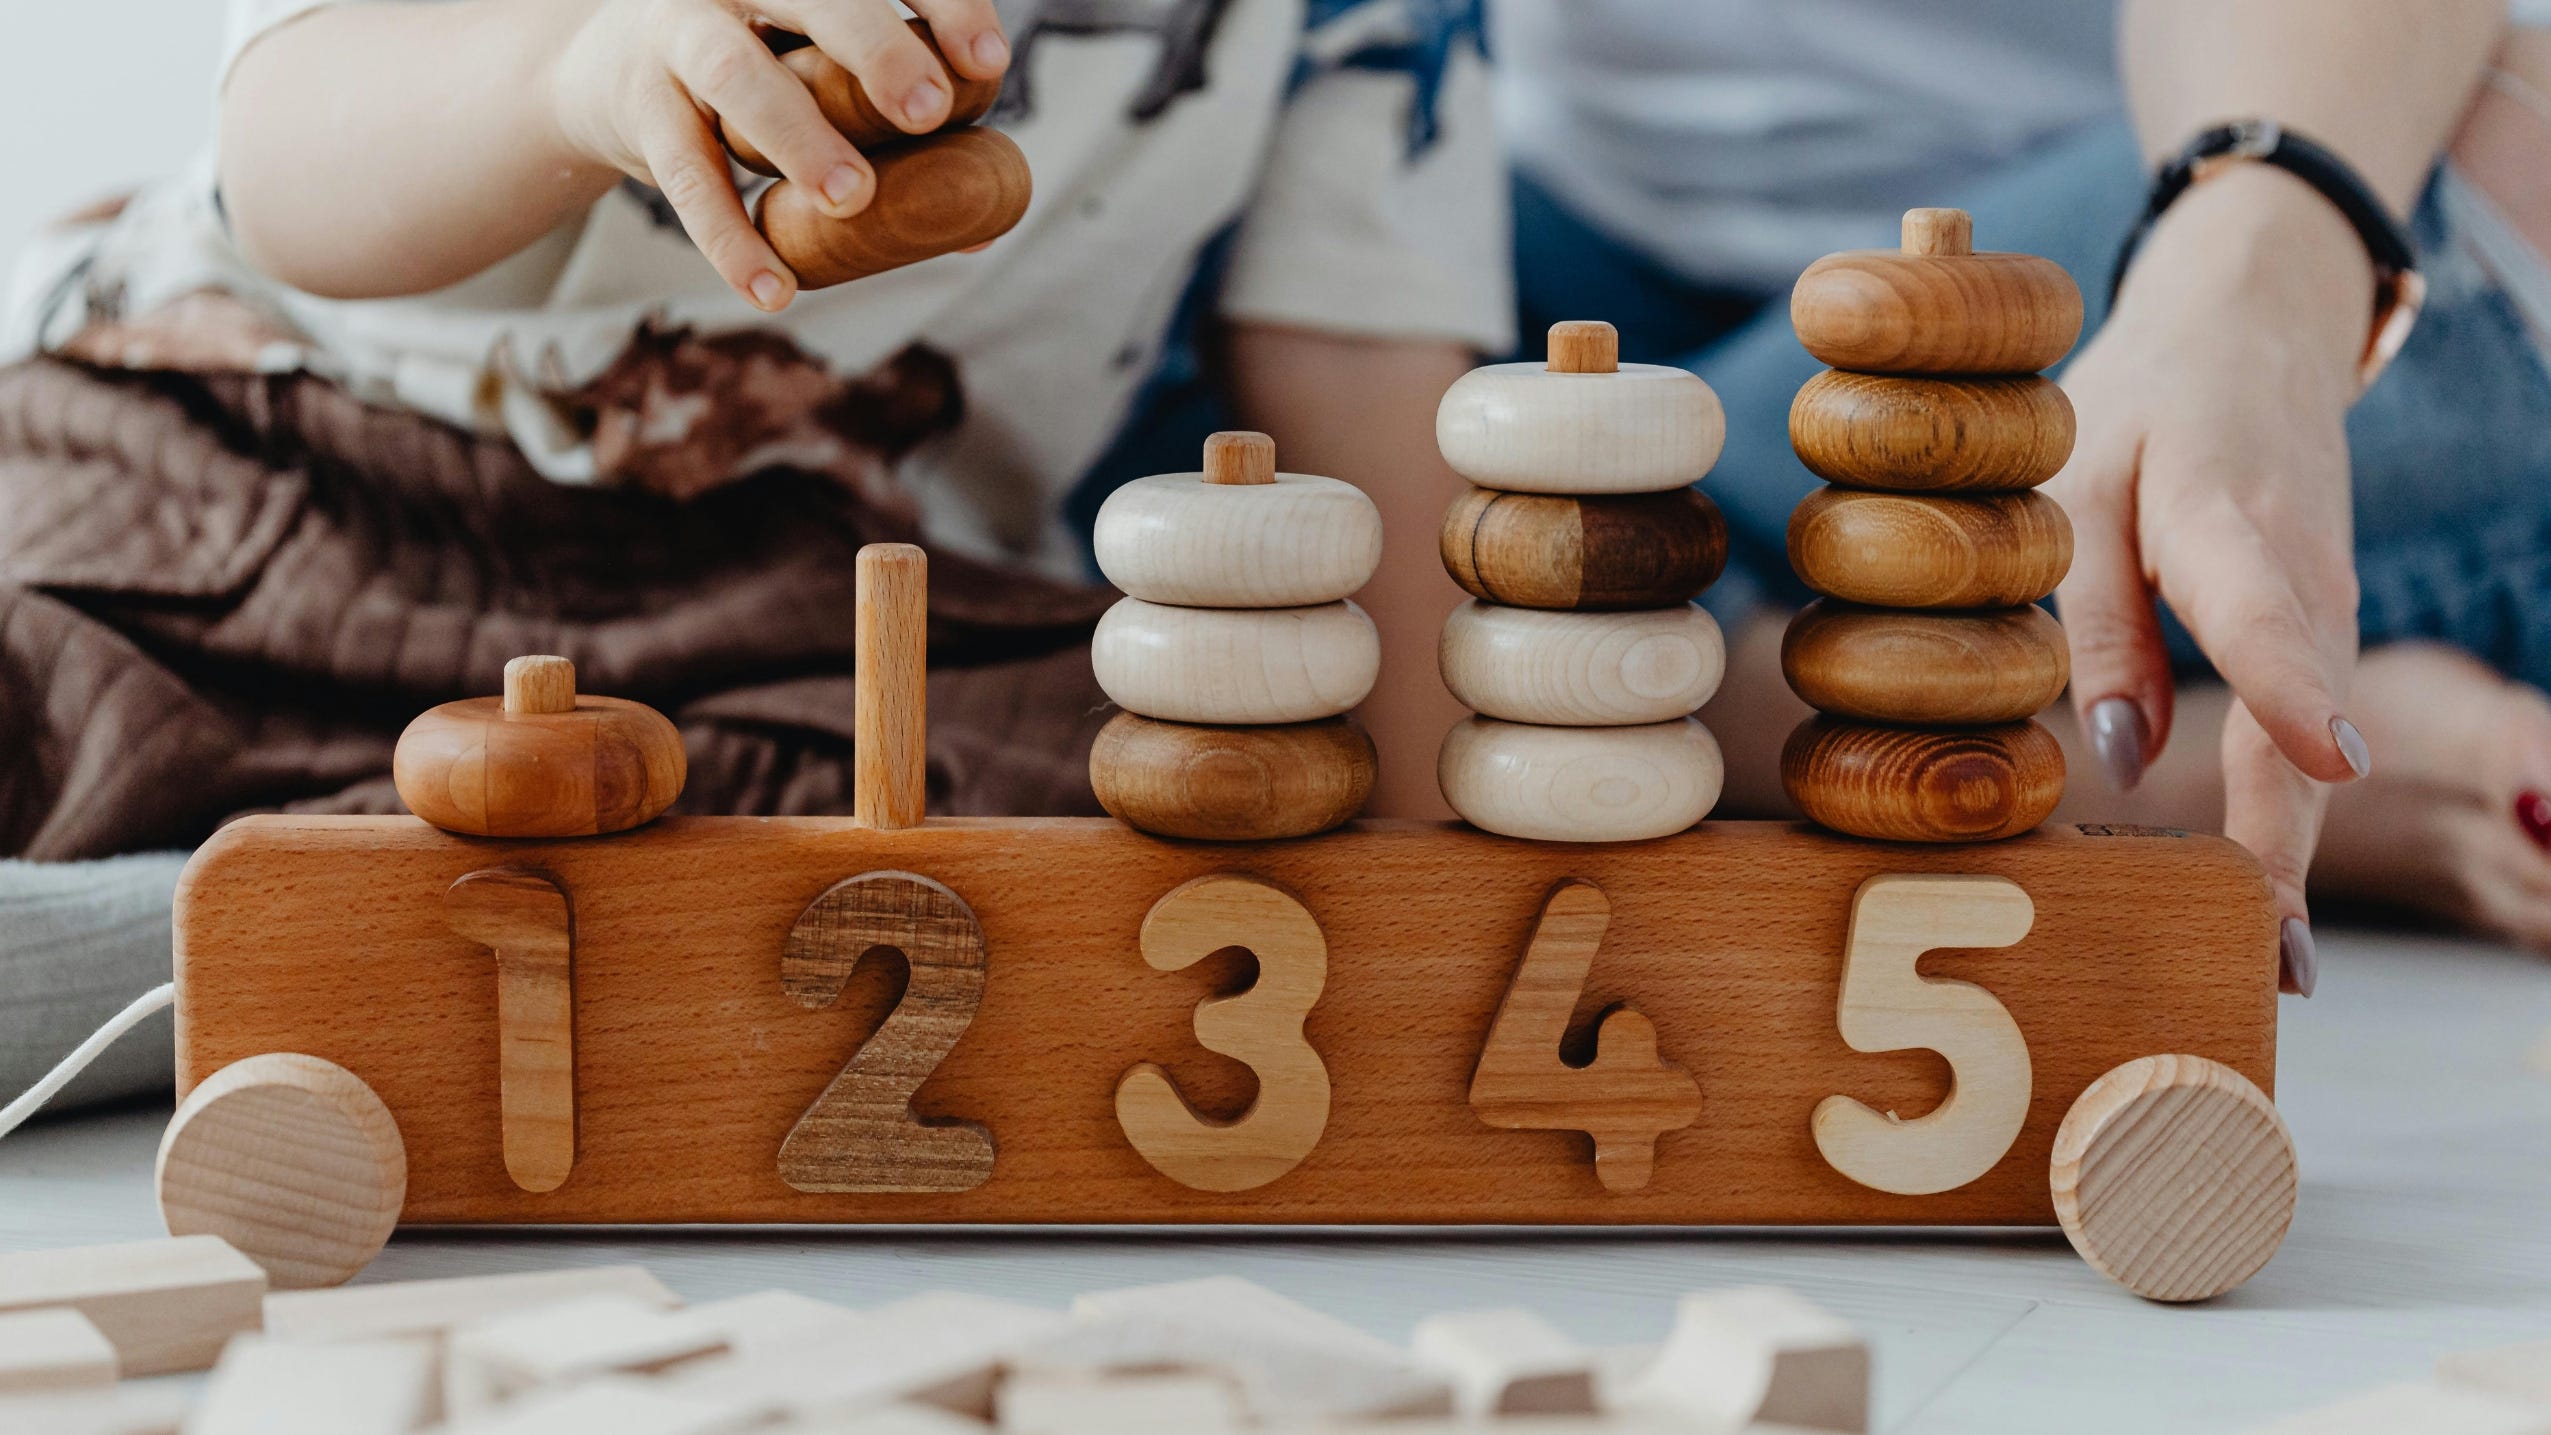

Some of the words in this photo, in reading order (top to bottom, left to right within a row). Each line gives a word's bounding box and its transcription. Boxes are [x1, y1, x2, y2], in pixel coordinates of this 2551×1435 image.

[444, 867, 575, 1192] 1
[777, 870, 995, 1193] 2
[1115, 874, 1331, 1192] 3
[1469, 877, 1701, 1192] 4
[1811, 873, 2034, 1195] 5
